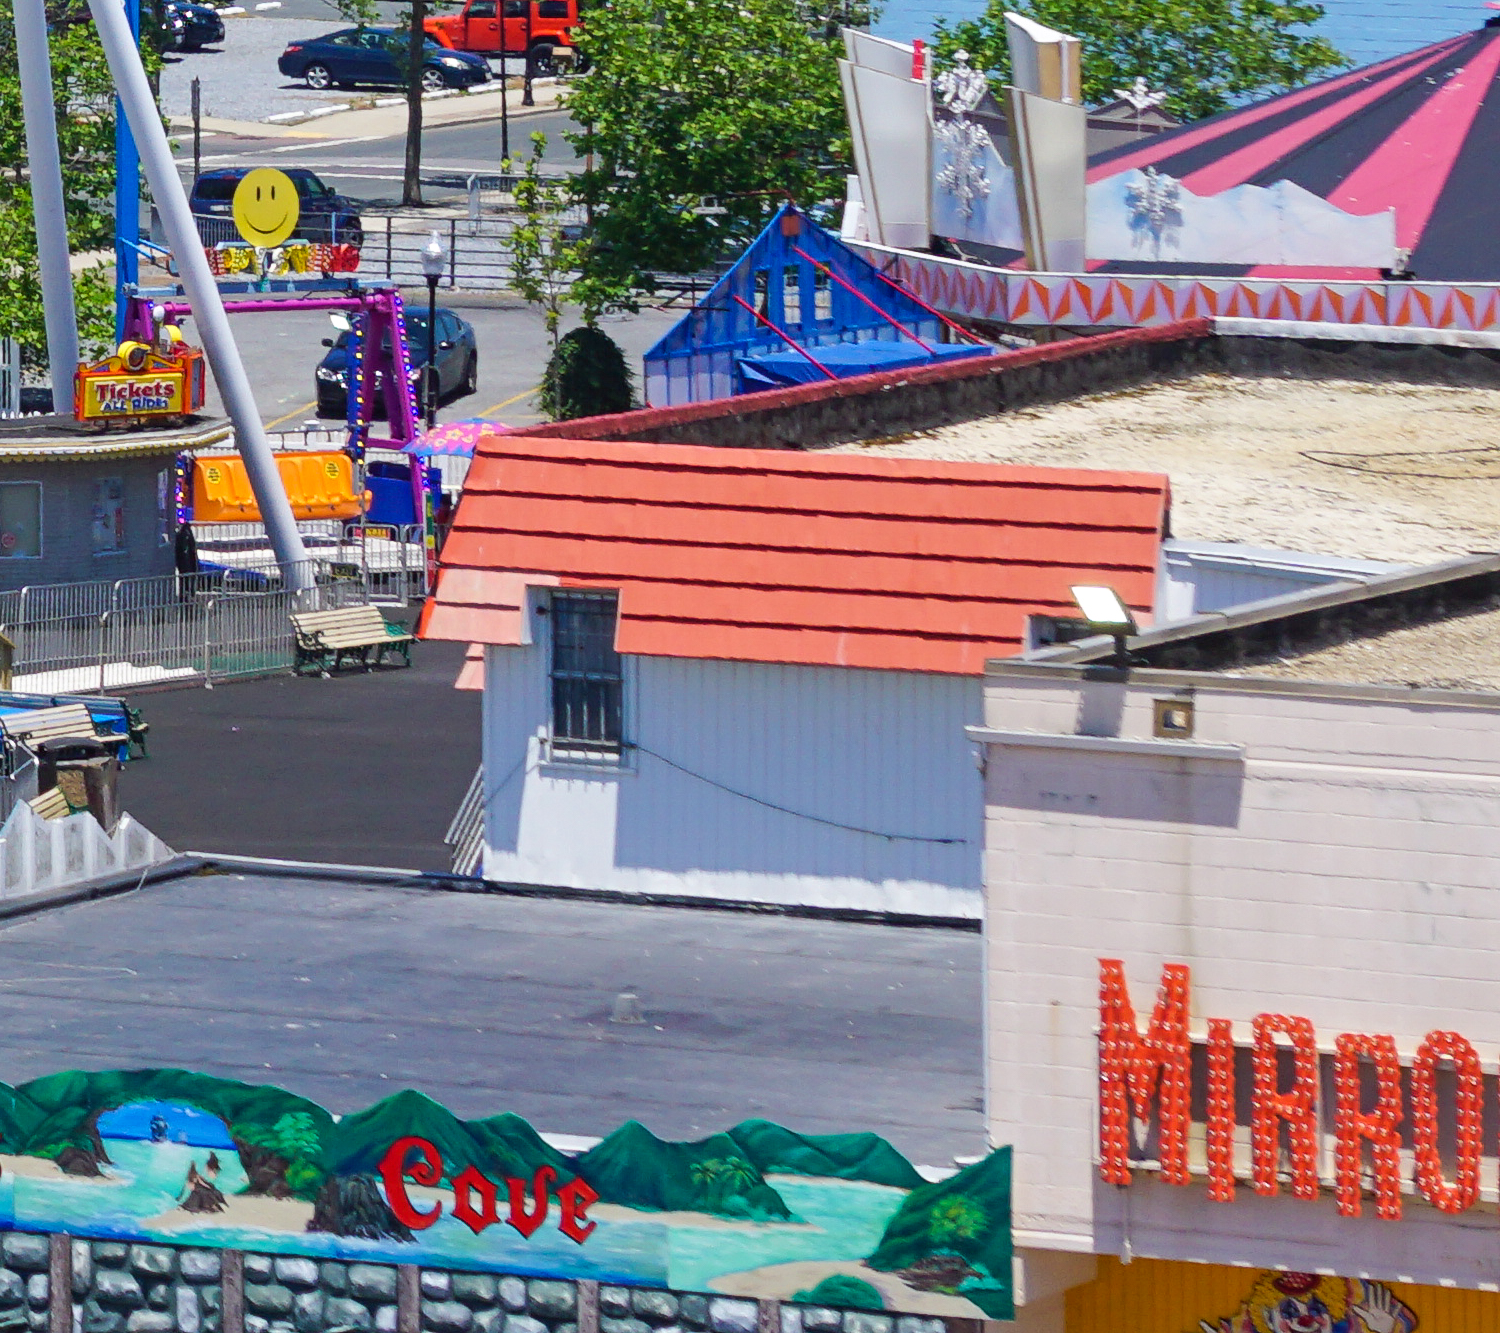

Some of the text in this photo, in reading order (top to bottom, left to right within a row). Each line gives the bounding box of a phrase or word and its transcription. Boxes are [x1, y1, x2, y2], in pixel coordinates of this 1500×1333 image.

[94, 379, 175, 402] Tickets
[100, 400, 127, 413] ALL
[376, 1135, 600, 1245] Cove
